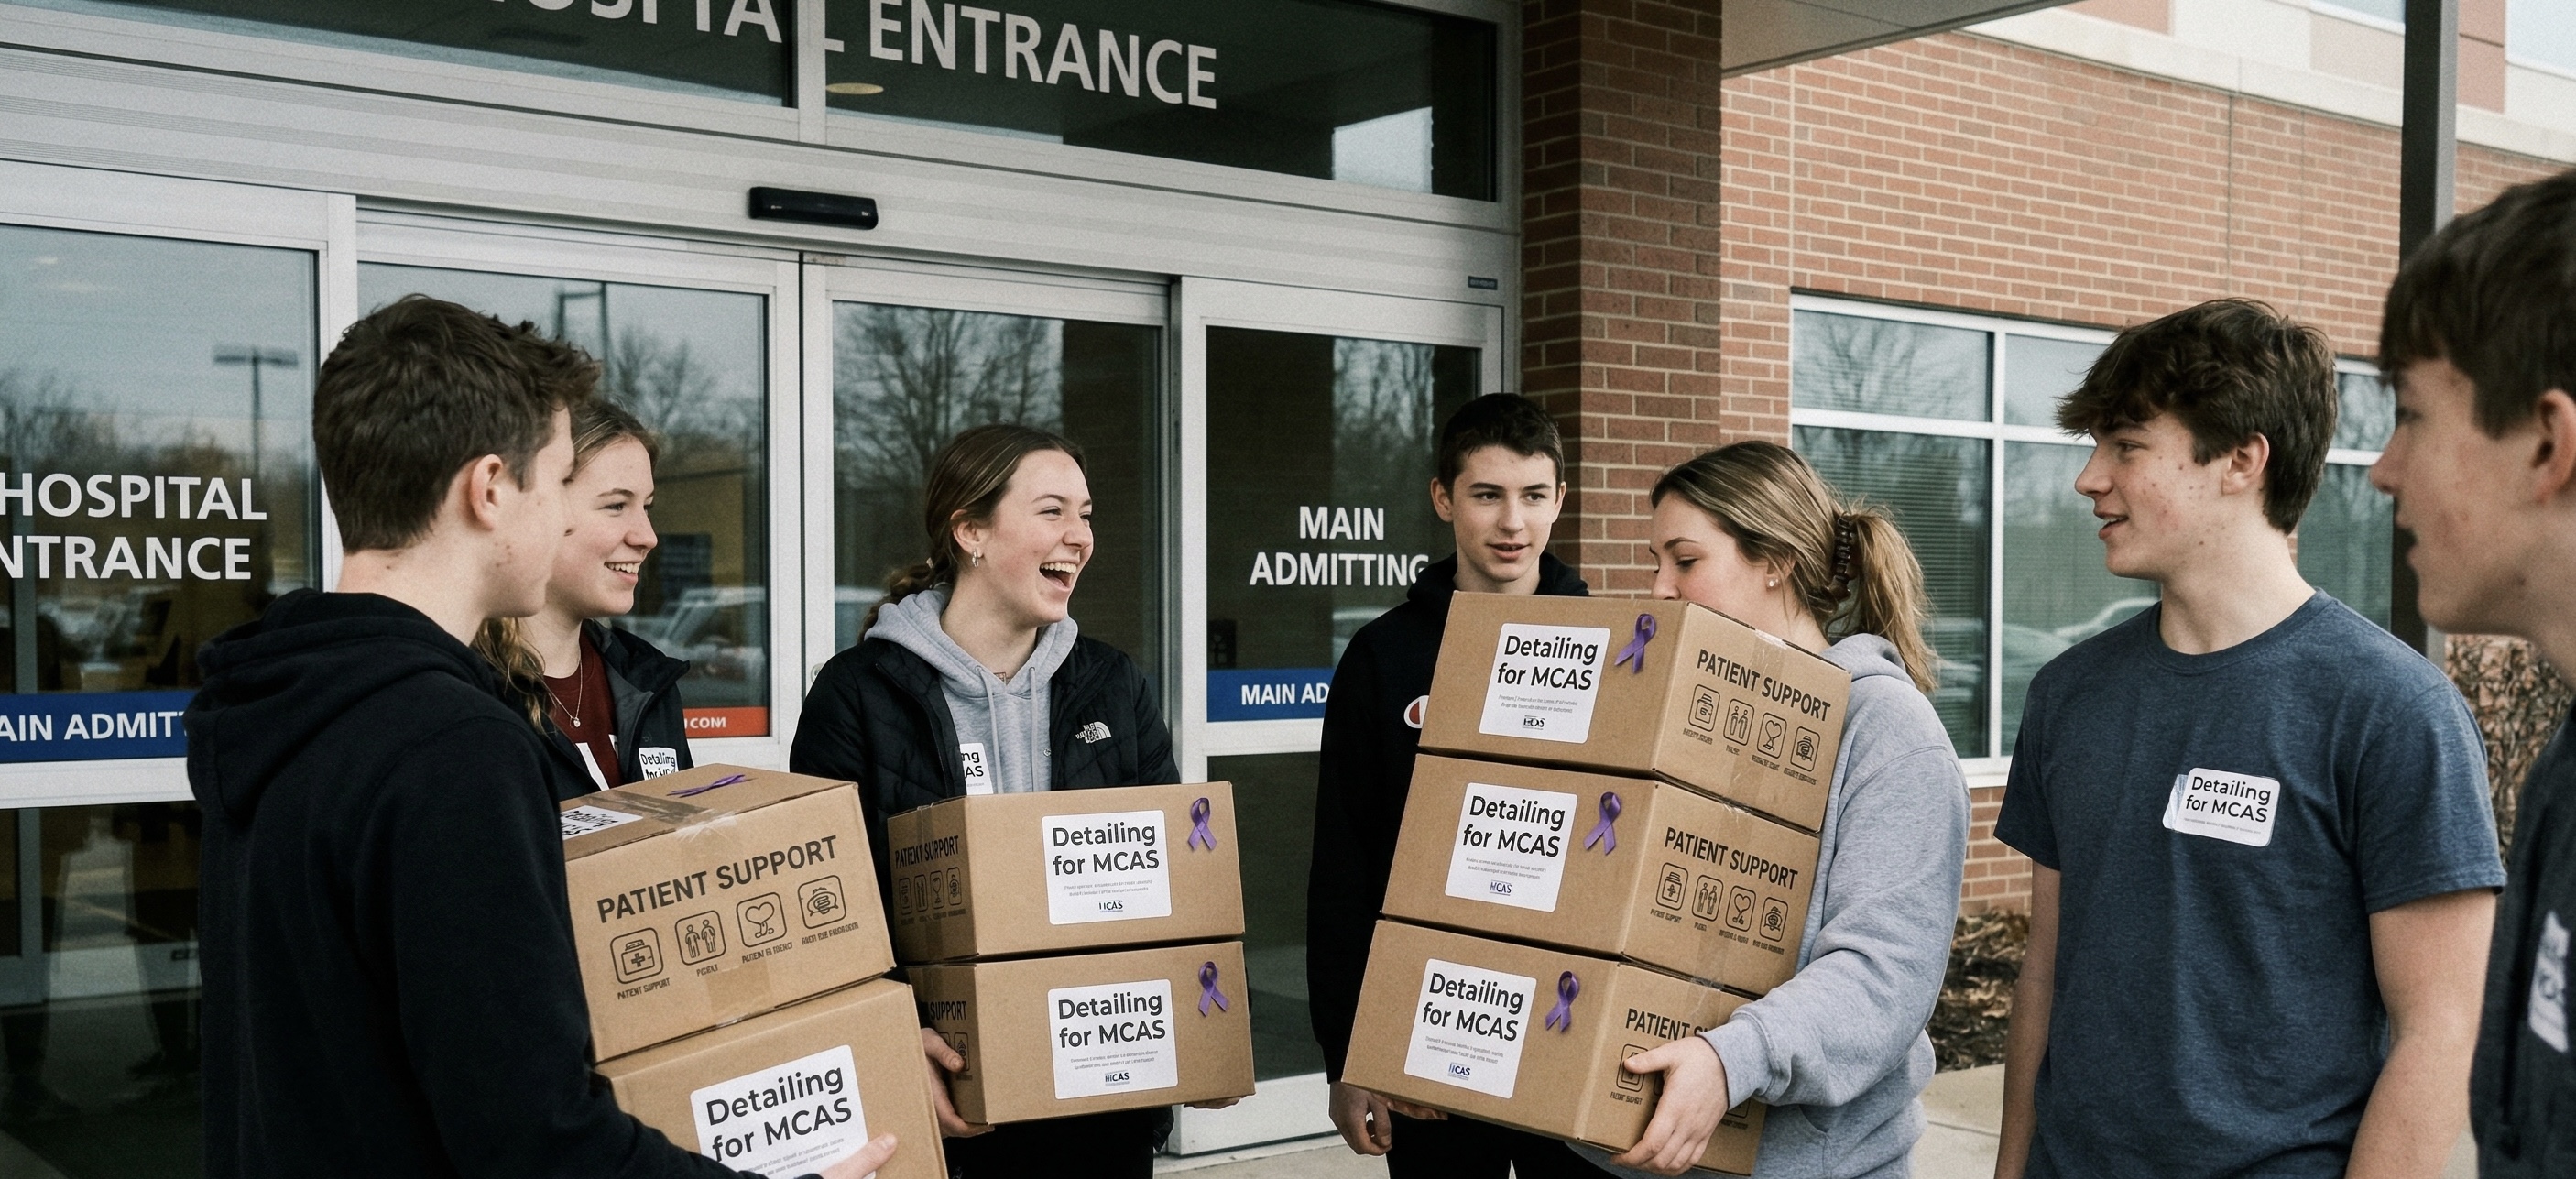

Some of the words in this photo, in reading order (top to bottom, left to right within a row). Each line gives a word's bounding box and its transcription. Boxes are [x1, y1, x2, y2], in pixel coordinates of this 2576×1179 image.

[869, 0, 1217, 109] ENTRANCE
[0, 472, 267, 520] HOSPITAL
[1299, 506, 1384, 540] MAIN
[1504, 635, 1598, 666] Detailing
[1497, 662, 1526, 685] for
[1531, 666, 1593, 690] MCAS
[1697, 649, 1760, 692] PATIENT
[1761, 676, 1831, 722] SUPPORT
[1241, 684, 1295, 705] MAIN
[63, 711, 186, 740] ADMIT
[965, 765, 984, 778] AS
[2191, 776, 2271, 805] Detailing
[1469, 795, 1566, 831] Detailing
[2186, 794, 2208, 812] for
[2211, 799, 2268, 823] MCAS
[924, 835, 959, 862] SUPPORT
[1053, 821, 1155, 847] Detailing
[1463, 824, 1492, 847] for
[1497, 829, 1561, 857] MCAS
[1053, 855, 1086, 876] for
[1093, 849, 1160, 873] MCAS
[1664, 826, 1729, 866] PATIENT
[1729, 849, 1798, 890] SUPPORT
[597, 870, 708, 923] PATIENT
[715, 835, 837, 890] SUPPORT
[1058, 991, 1162, 1020] Detailing
[1429, 972, 1524, 1015] Detailing
[930, 1000, 967, 1021] SUPPORT
[1423, 1001, 1451, 1027] for
[1456, 1009, 1519, 1042] MCAS
[1625, 1008, 1690, 1041] PATIENT
[1059, 1027, 1091, 1048] for
[1098, 1019, 1166, 1044] MCAS
[706, 1067, 844, 1126] Detailing
[712, 1131, 754, 1163] for
[764, 1097, 852, 1146] MCAS
